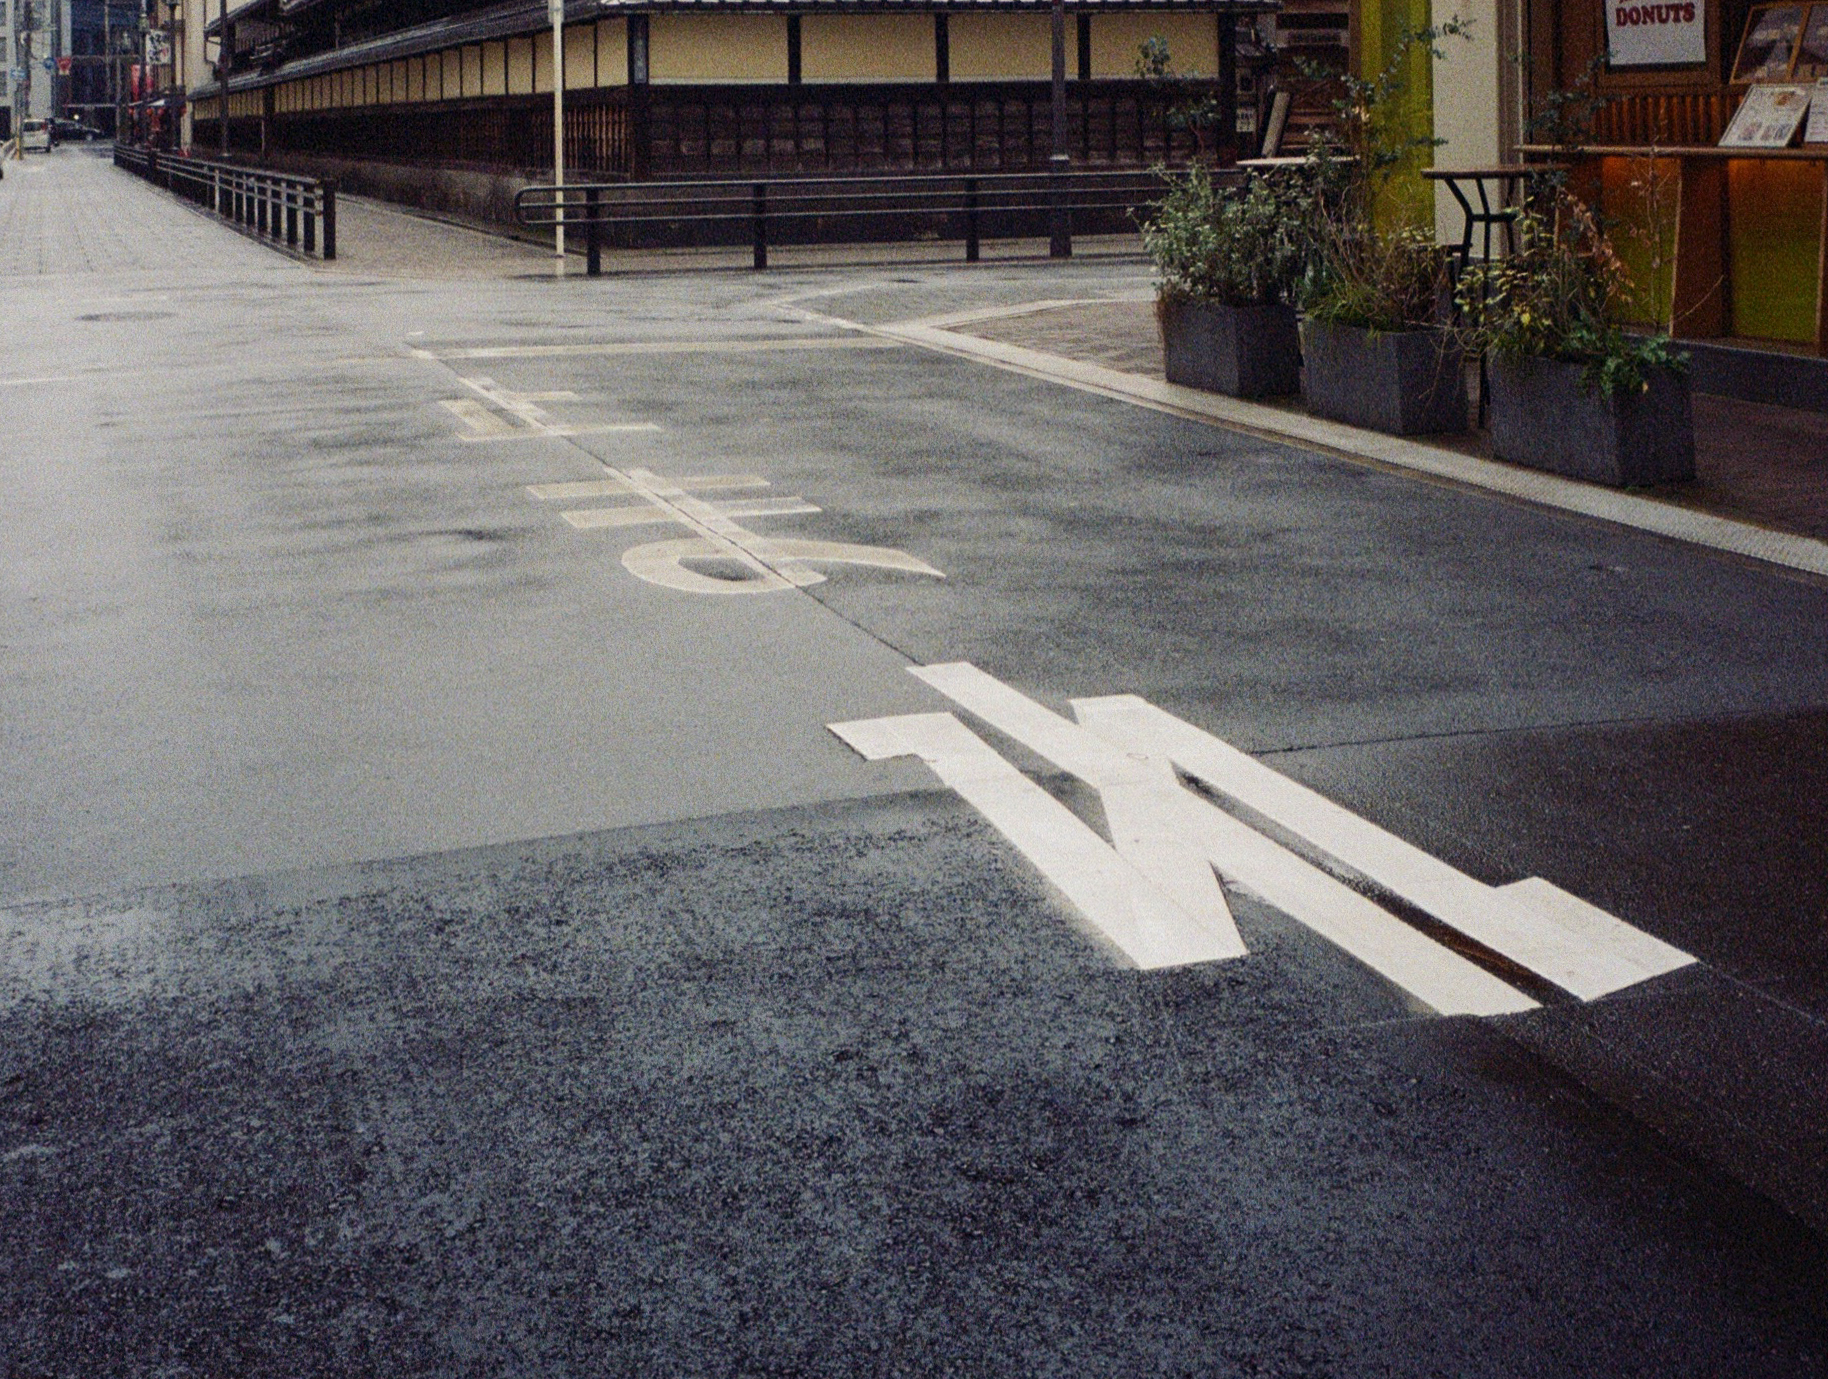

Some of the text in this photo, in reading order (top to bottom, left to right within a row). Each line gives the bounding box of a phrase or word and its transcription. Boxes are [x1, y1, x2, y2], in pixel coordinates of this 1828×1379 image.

[1615, 2, 1696, 27] DONUTS
[438, 376, 1697, 1017] 止まれ
